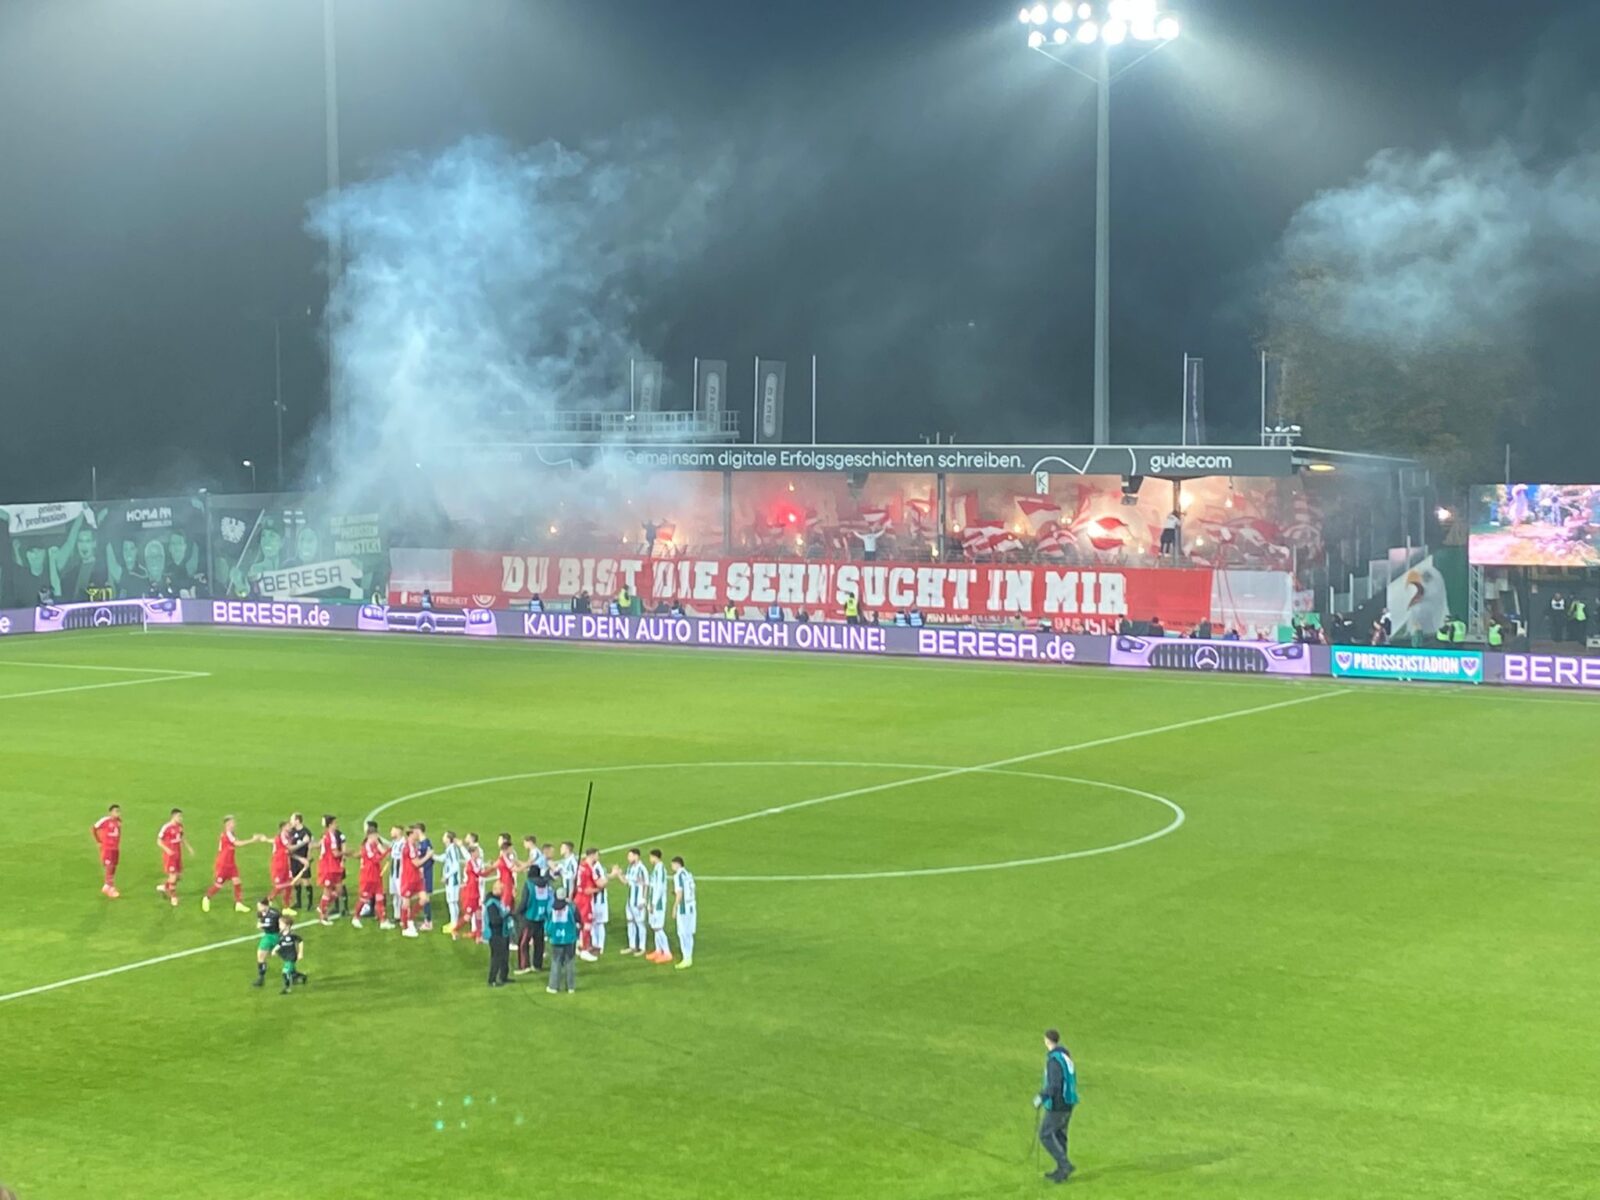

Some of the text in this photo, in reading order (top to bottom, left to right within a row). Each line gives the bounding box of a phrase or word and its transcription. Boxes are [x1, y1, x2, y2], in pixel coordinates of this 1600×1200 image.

[624, 450, 1026, 470] Gemeinsam digitale Erfolgsgeschichten schreiben.
[1150, 452, 1233, 473] guidecom
[263, 566, 342, 593] BERESA
[501, 556, 1128, 615] DU BIST DIE SEHNSUCHT IN MIR
[213, 600, 330, 626] BERESA.de
[523, 613, 886, 651] KAUF DEIN AUTO EINFACH ONLINE!
[918, 629, 1076, 660] BERESA.de
[1353, 652, 1460, 674] PREUSSENSTADION
